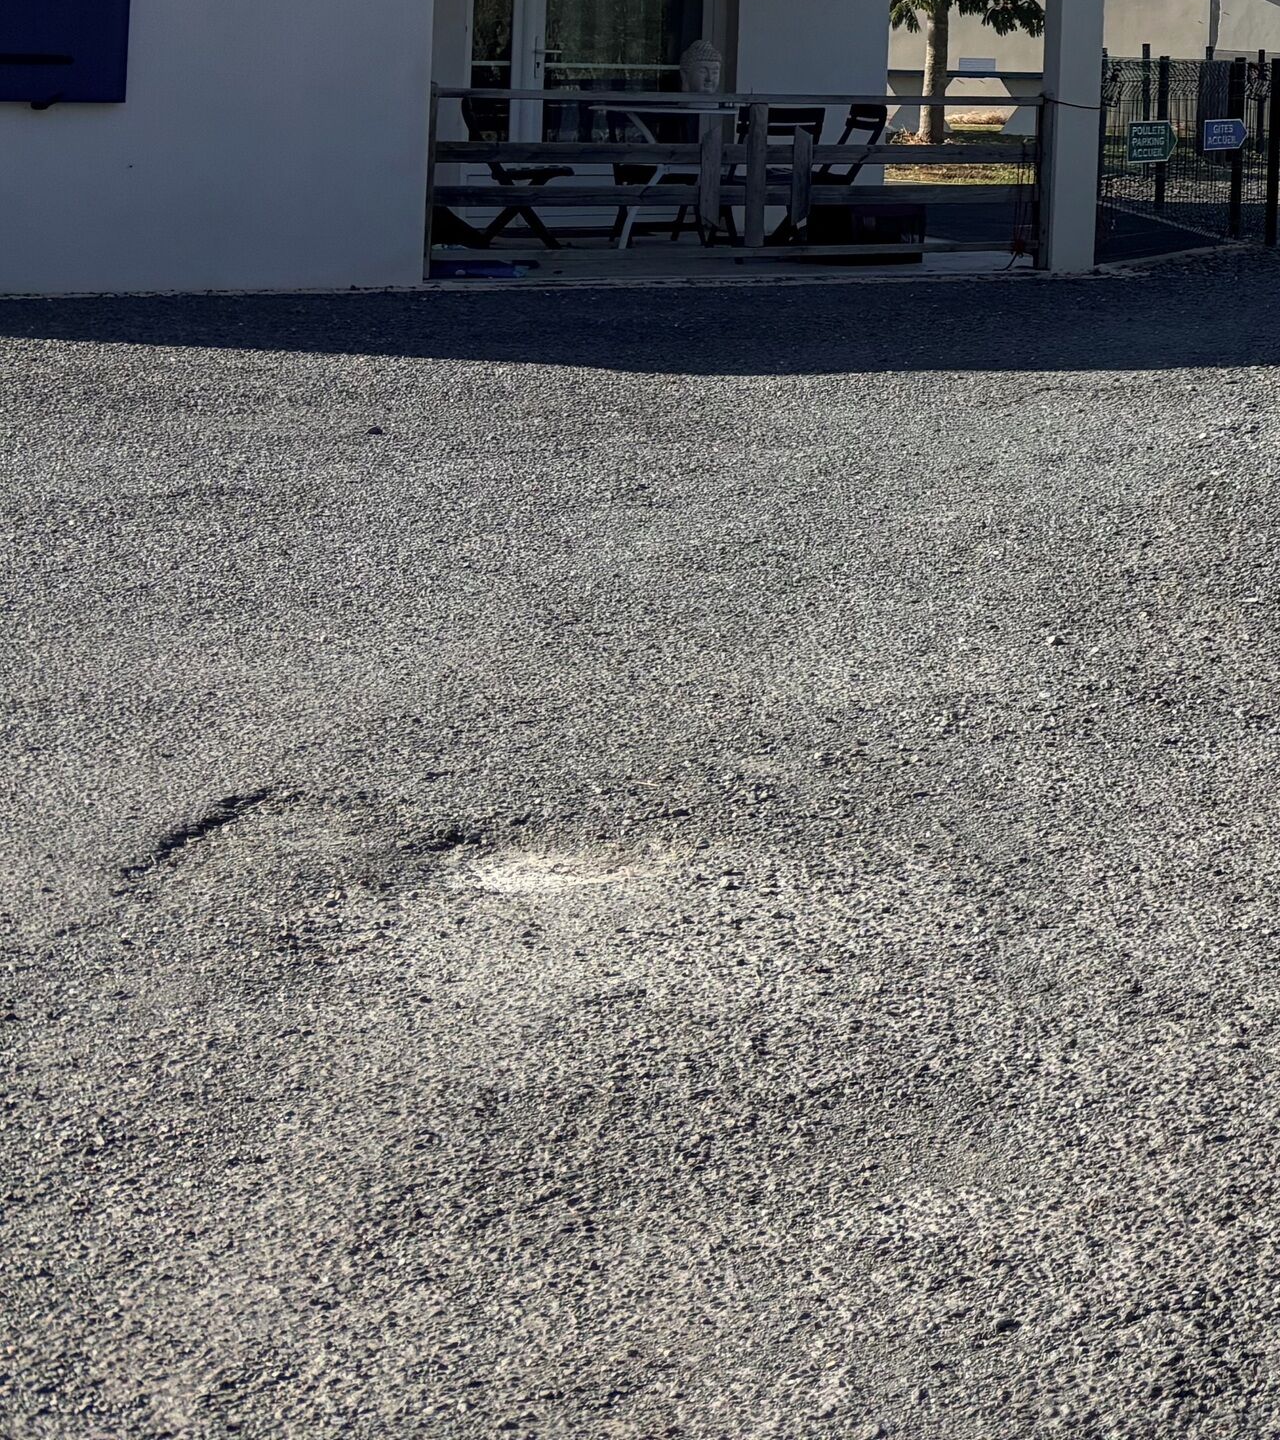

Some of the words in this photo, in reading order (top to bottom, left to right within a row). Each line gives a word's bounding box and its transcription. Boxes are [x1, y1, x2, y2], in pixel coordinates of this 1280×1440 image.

[1132, 125, 1165, 136] POULETS
[1132, 137, 1165, 147] PARKING
[1132, 148, 1164, 158] ACCUEIL
